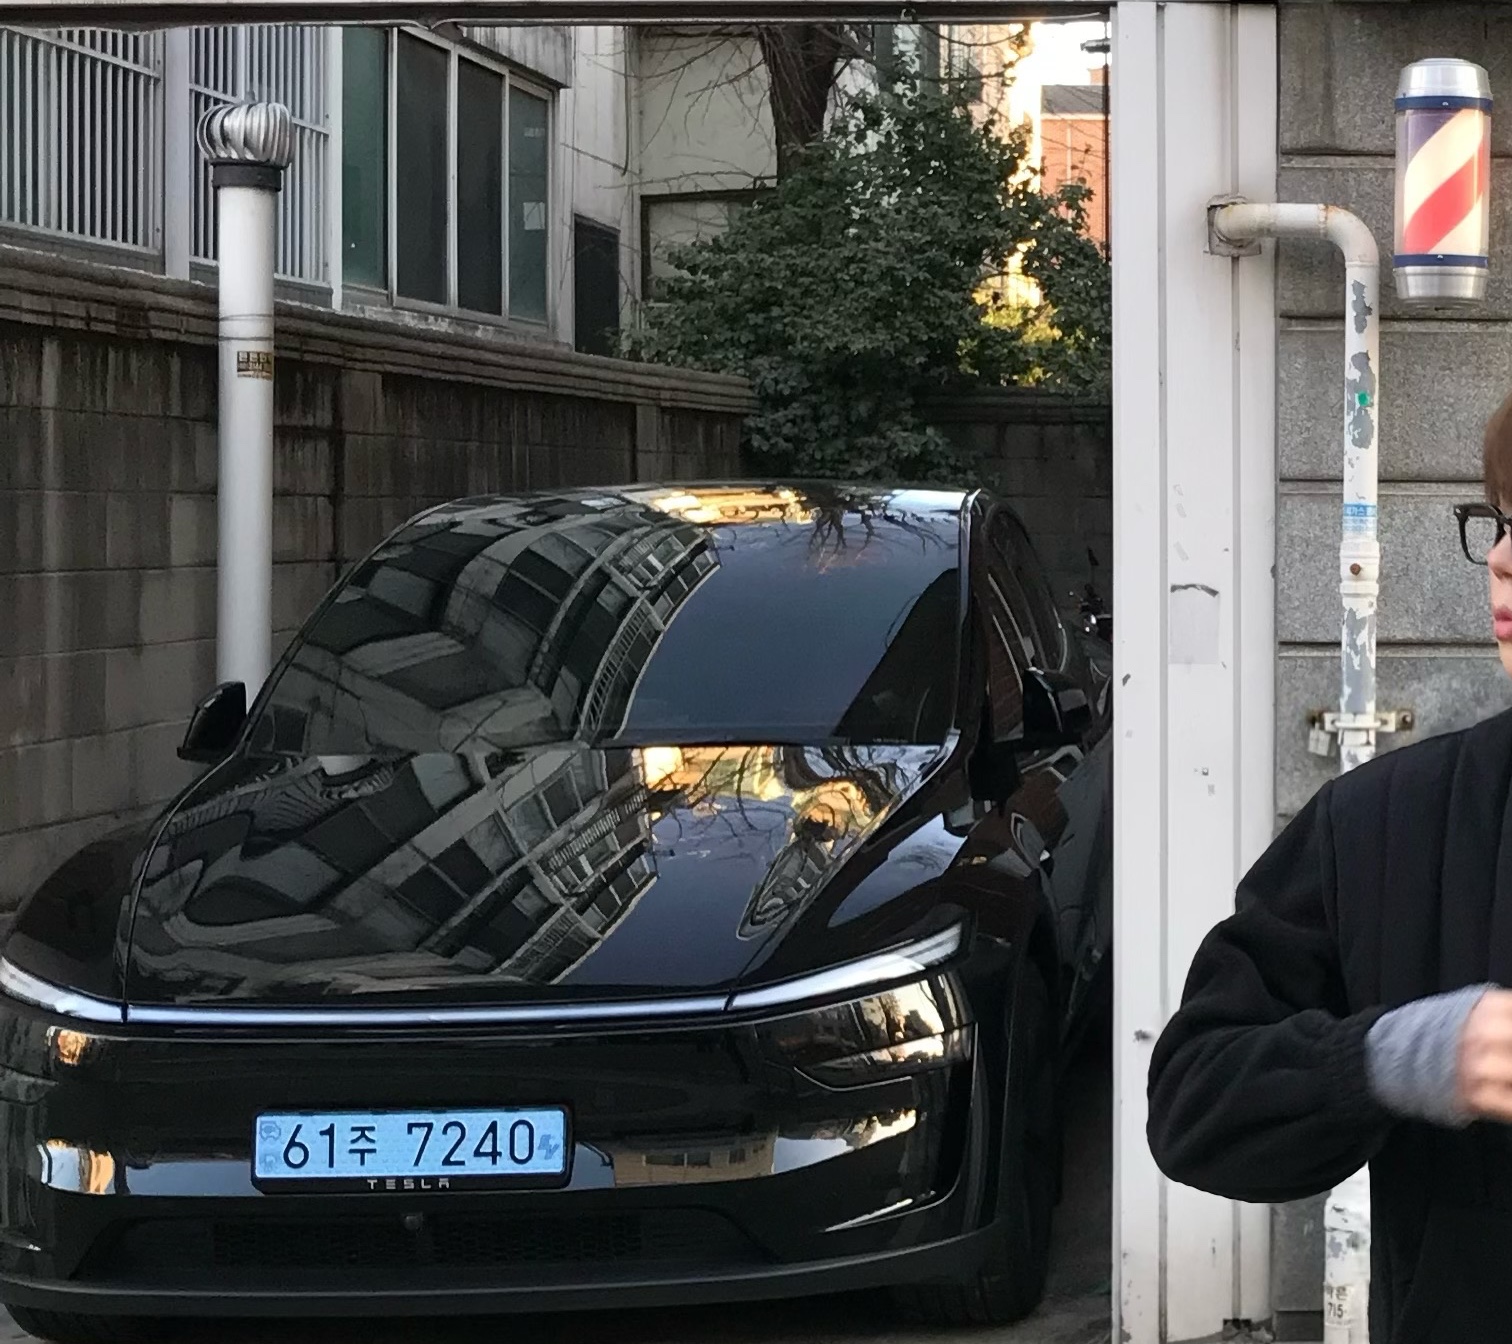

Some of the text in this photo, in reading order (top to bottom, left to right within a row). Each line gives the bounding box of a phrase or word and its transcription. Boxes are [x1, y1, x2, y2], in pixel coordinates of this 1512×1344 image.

[282, 1119, 536, 1169] 61주 7240
[366, 1177, 451, 1190] TESLA
